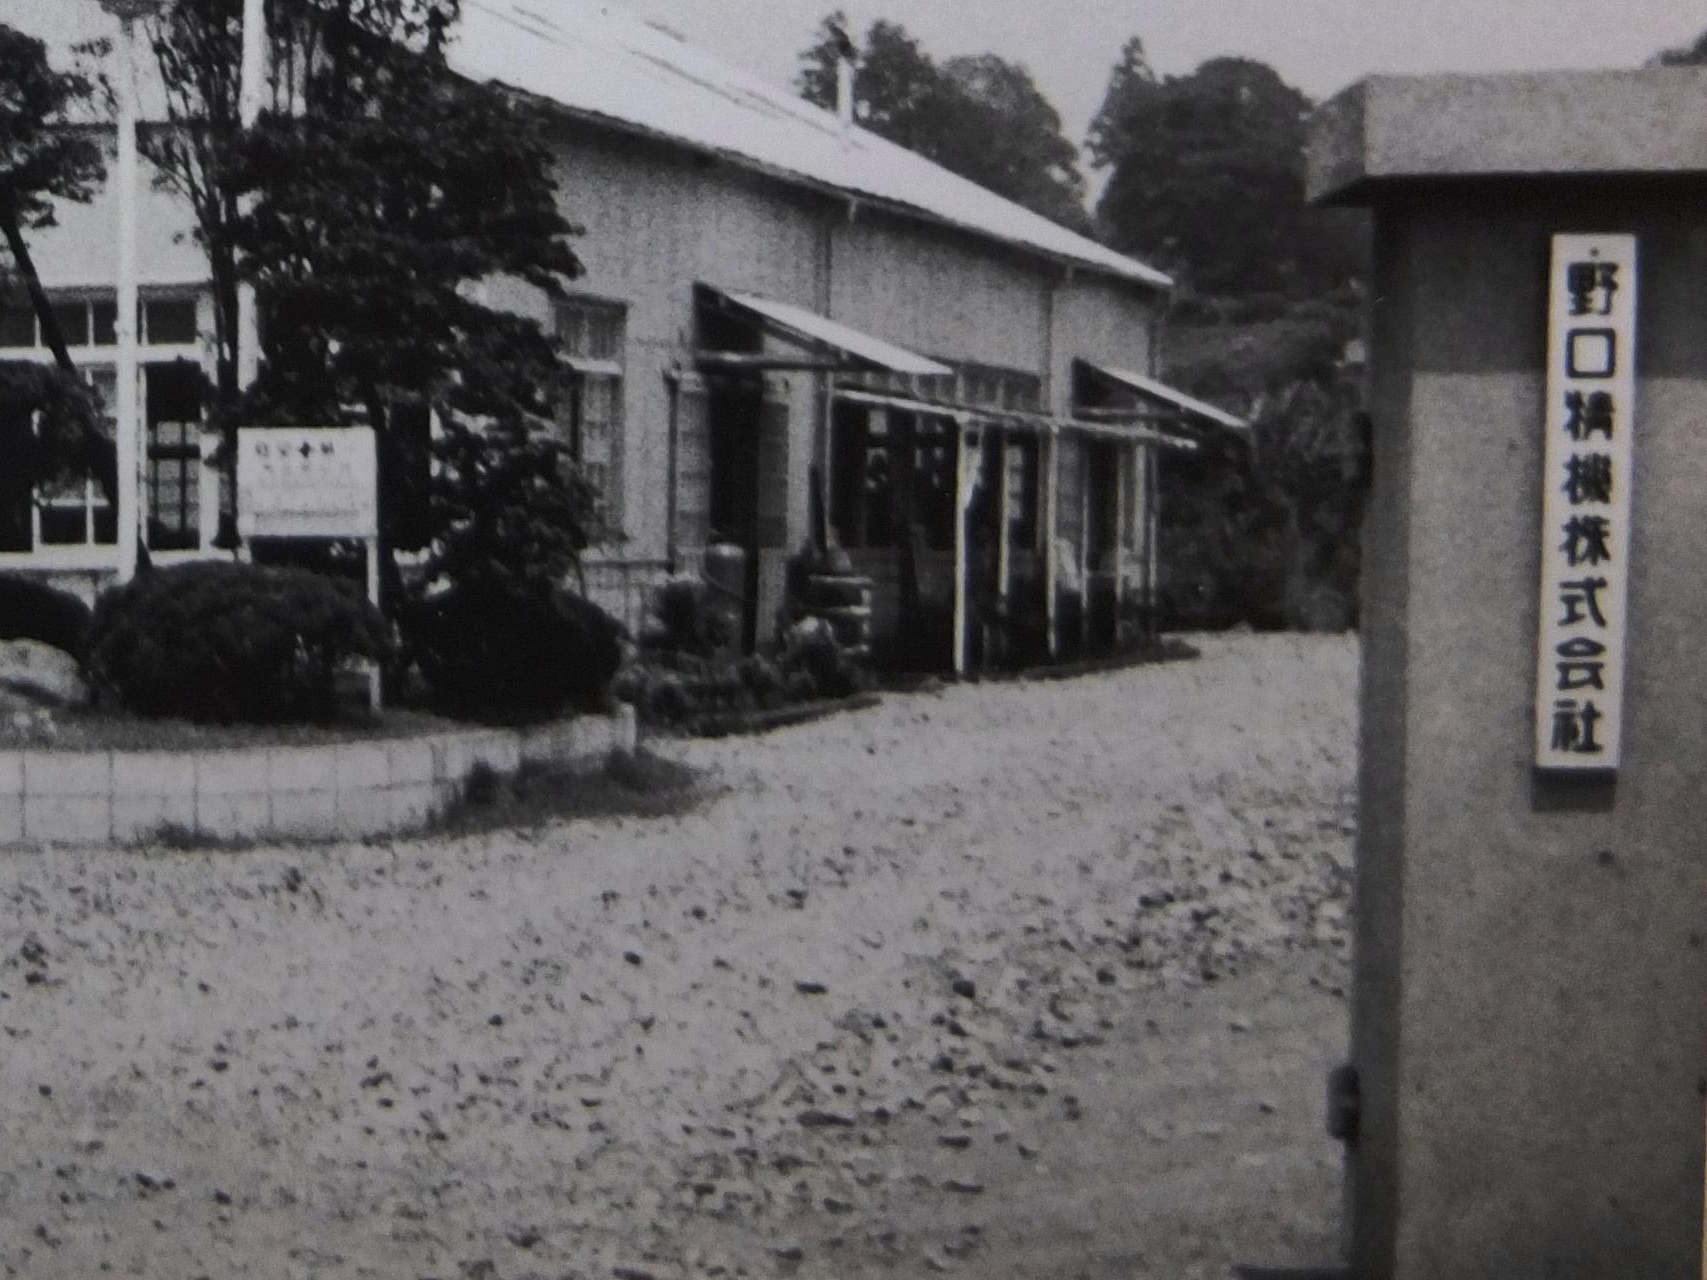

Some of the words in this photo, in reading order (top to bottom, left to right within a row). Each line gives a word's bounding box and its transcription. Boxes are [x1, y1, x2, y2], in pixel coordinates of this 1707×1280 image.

[1551, 262, 1619, 754] 野口精機株式会社
